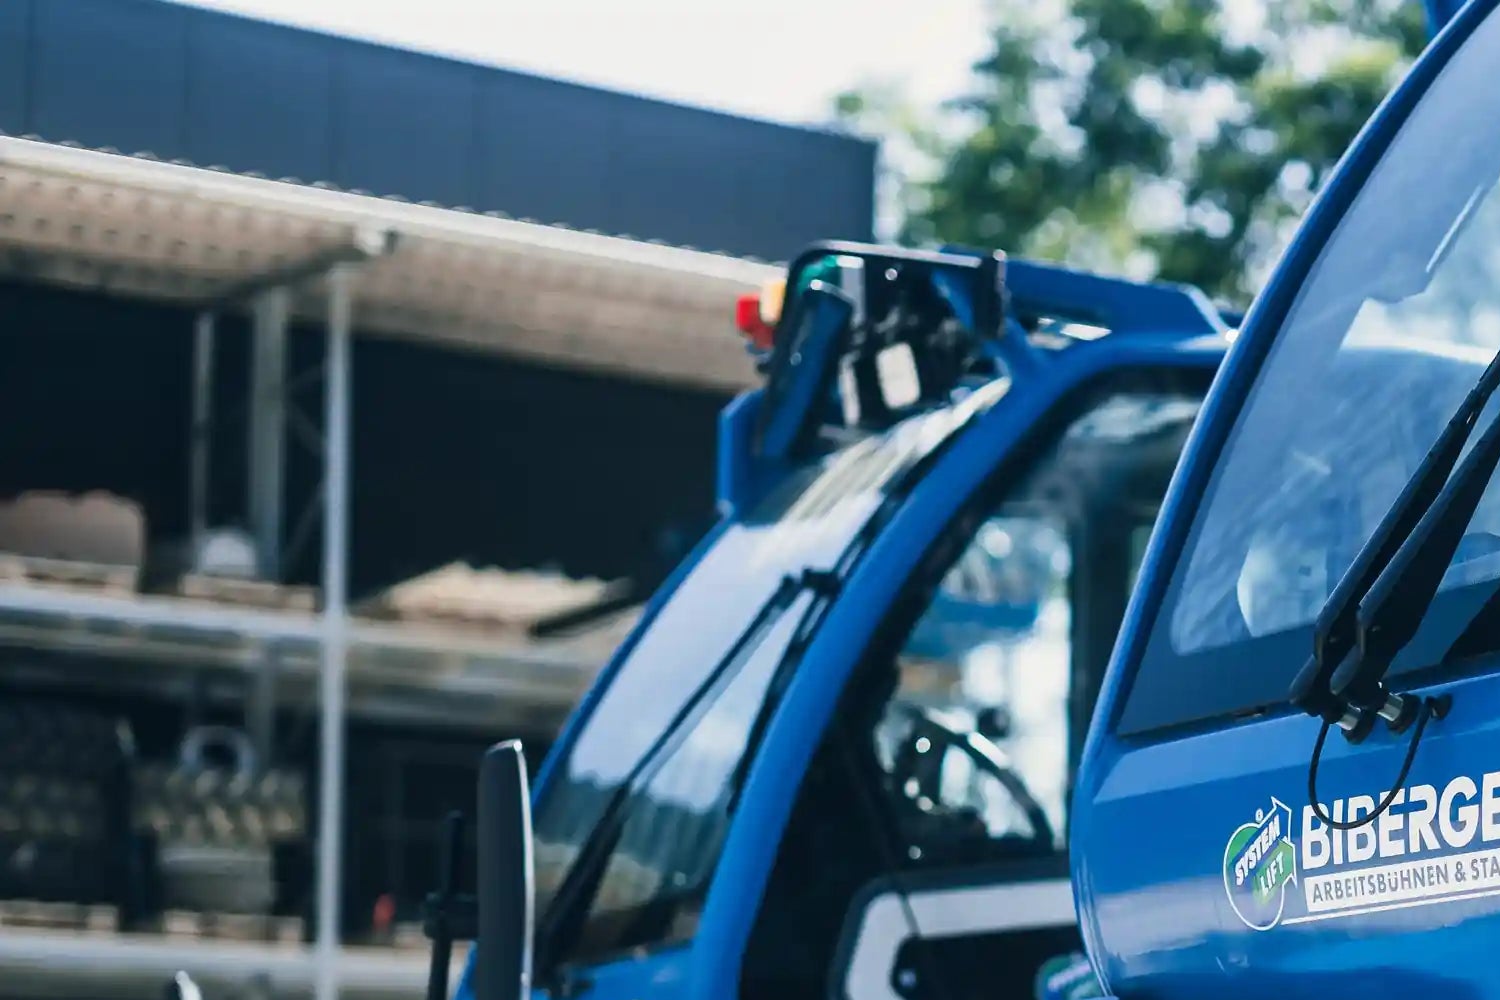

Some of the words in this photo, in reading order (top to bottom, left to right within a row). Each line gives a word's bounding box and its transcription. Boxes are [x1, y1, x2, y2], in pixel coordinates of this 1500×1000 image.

[1235, 814, 1280, 886] SYSTEM
[1261, 851, 1284, 897] LIFT
[1312, 862, 1449, 904] ARBEITSBÜHNEN
[1455, 860, 1467, 882] &
